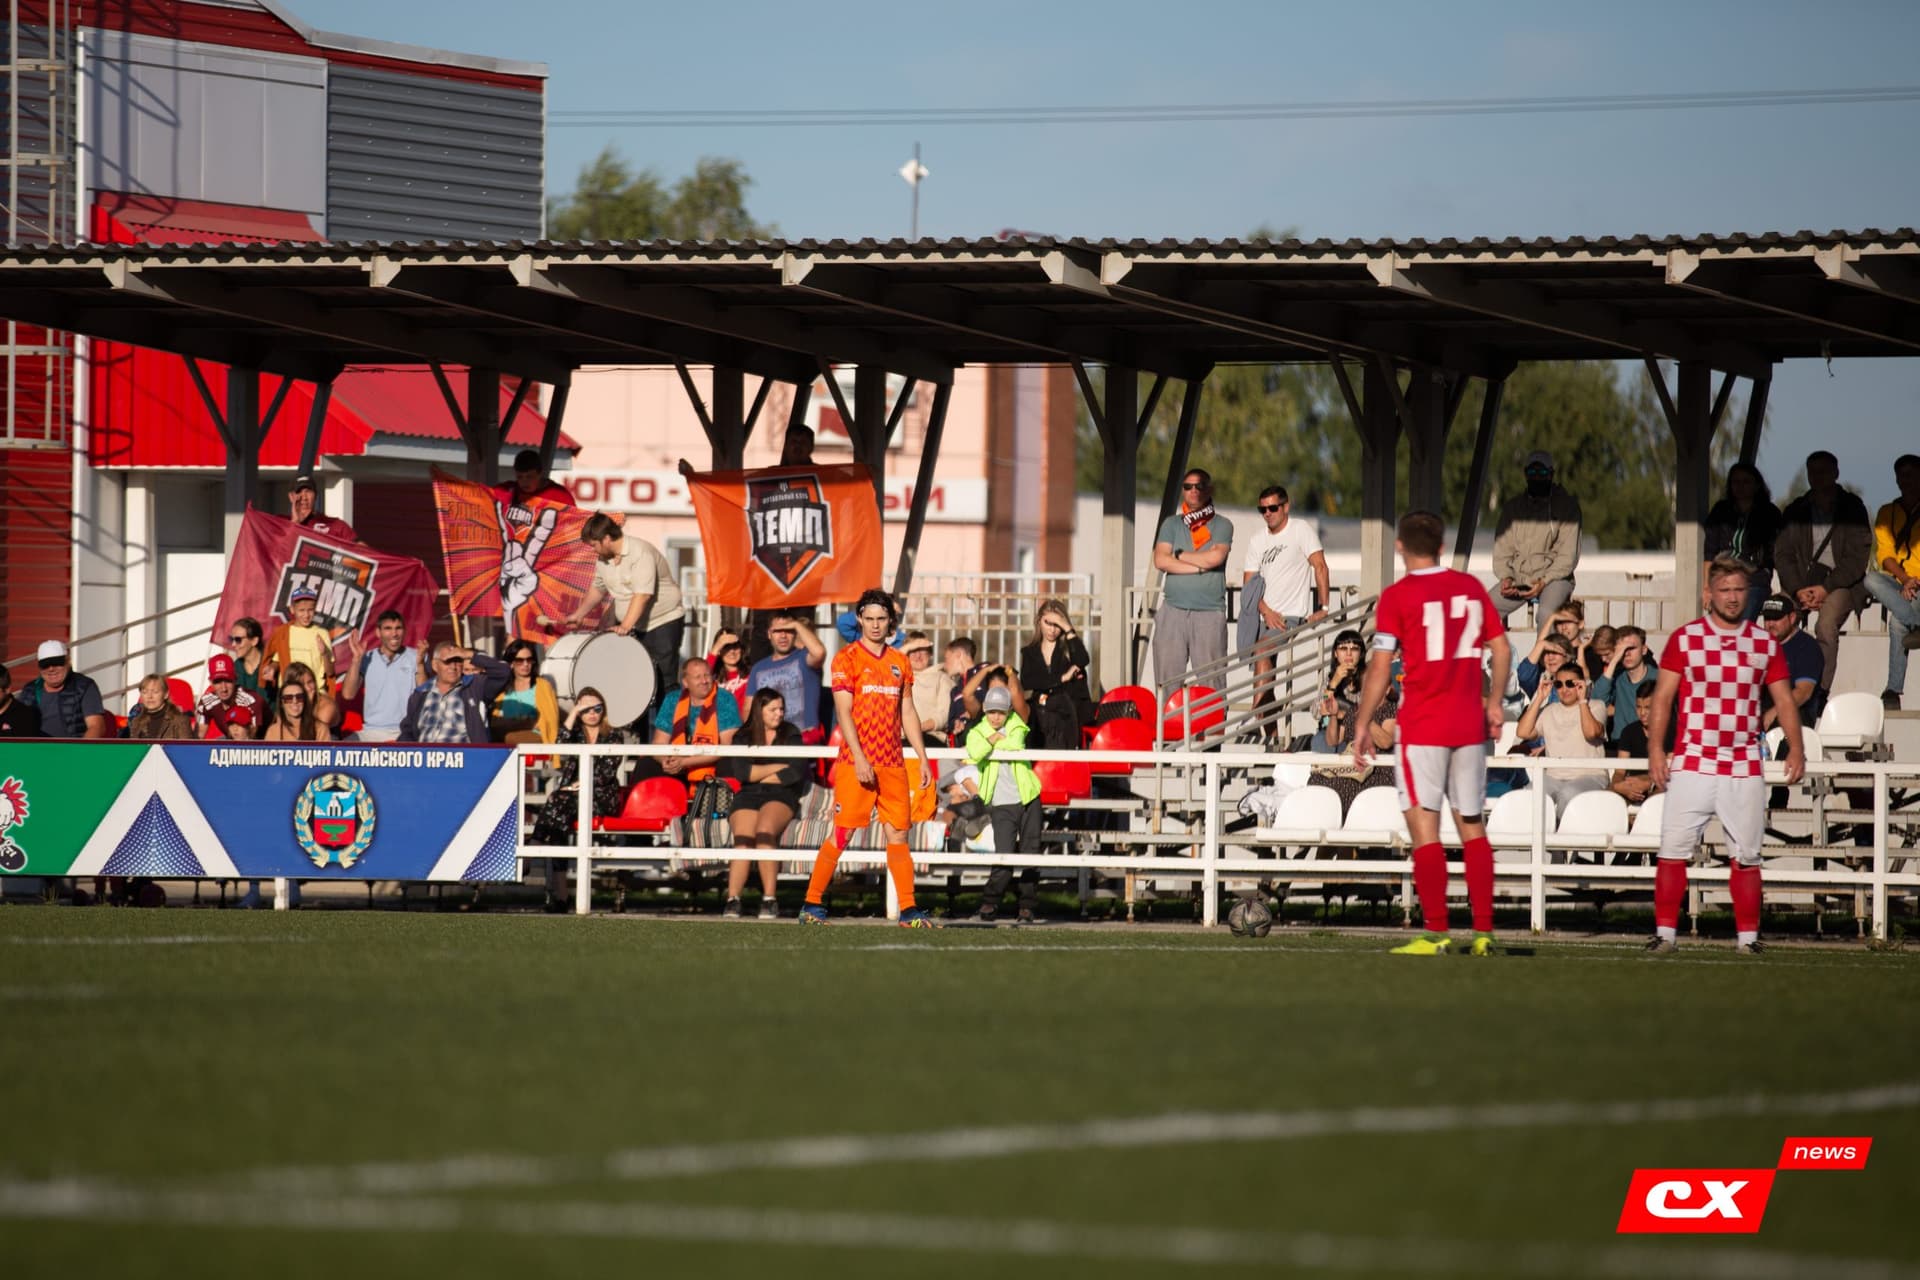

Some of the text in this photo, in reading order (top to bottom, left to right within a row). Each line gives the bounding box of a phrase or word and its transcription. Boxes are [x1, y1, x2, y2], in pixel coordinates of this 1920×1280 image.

[753, 507, 824, 547] ТЕМП
[286, 573, 365, 627] ТЕМП
[1422, 594, 1484, 662] 12
[209, 748, 464, 769] АДМИНИСТРАЦИЯ АЛТАЙСКОГО КРАЯ
